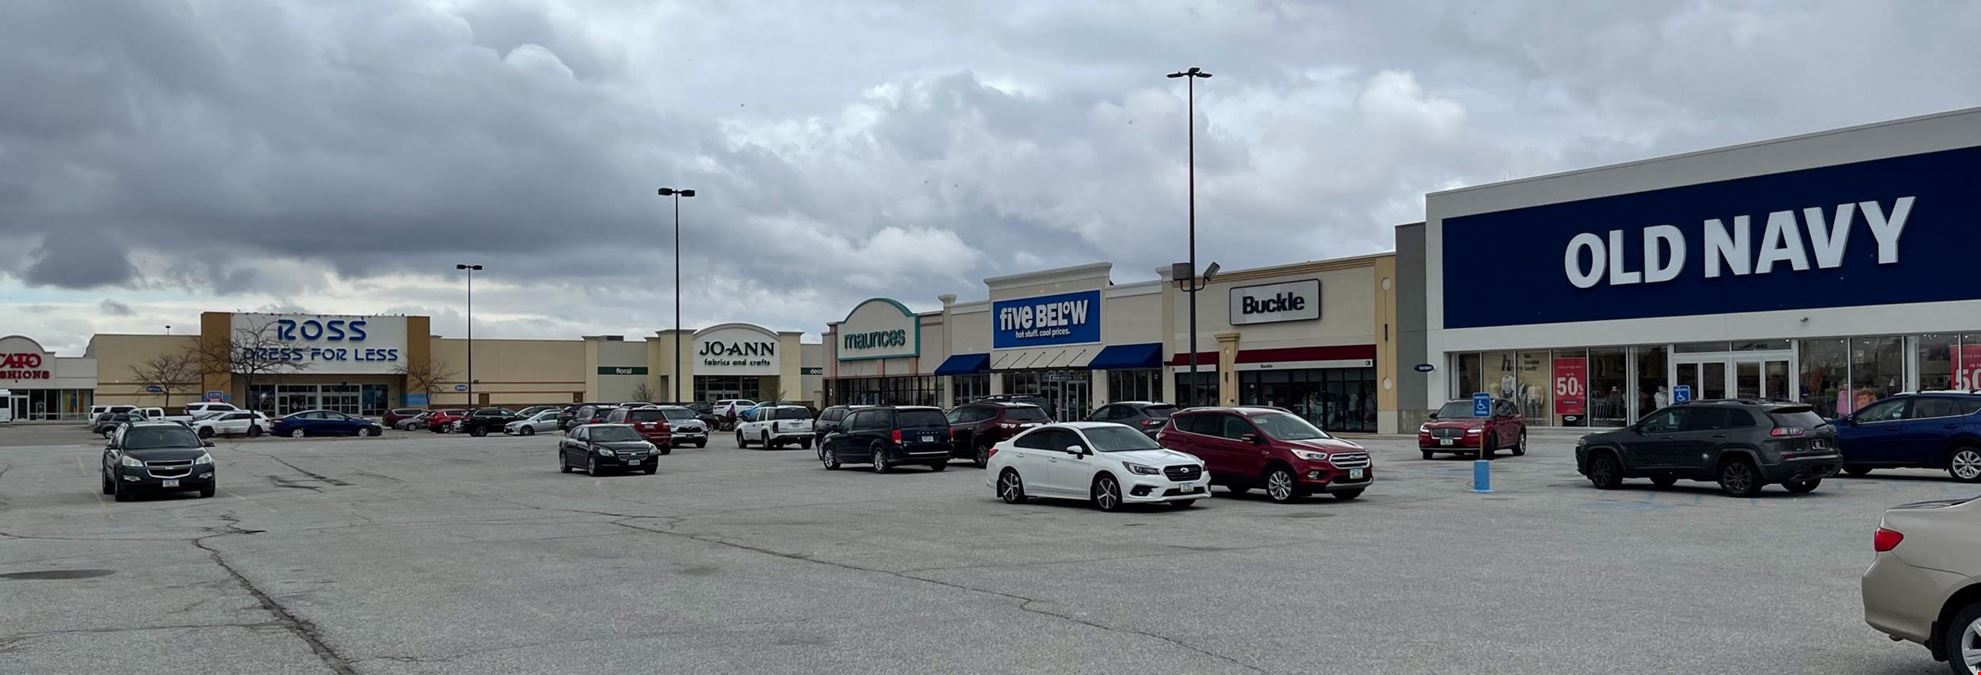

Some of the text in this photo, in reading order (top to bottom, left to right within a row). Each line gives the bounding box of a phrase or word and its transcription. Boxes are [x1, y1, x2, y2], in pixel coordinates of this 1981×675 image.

[1564, 196, 1916, 289] OLD NAVY
[1242, 292, 1305, 314] Buckle
[999, 305, 1033, 331] five
[277, 319, 367, 341] ROSS
[844, 328, 906, 350] maurices
[1015, 330, 1025, 338] hot
[1039, 328, 1052, 337] cool
[1052, 327, 1071, 338] prices.
[243, 348, 398, 361] DRESS FOR LESS
[704, 358, 771, 366] fabrics and crafts
